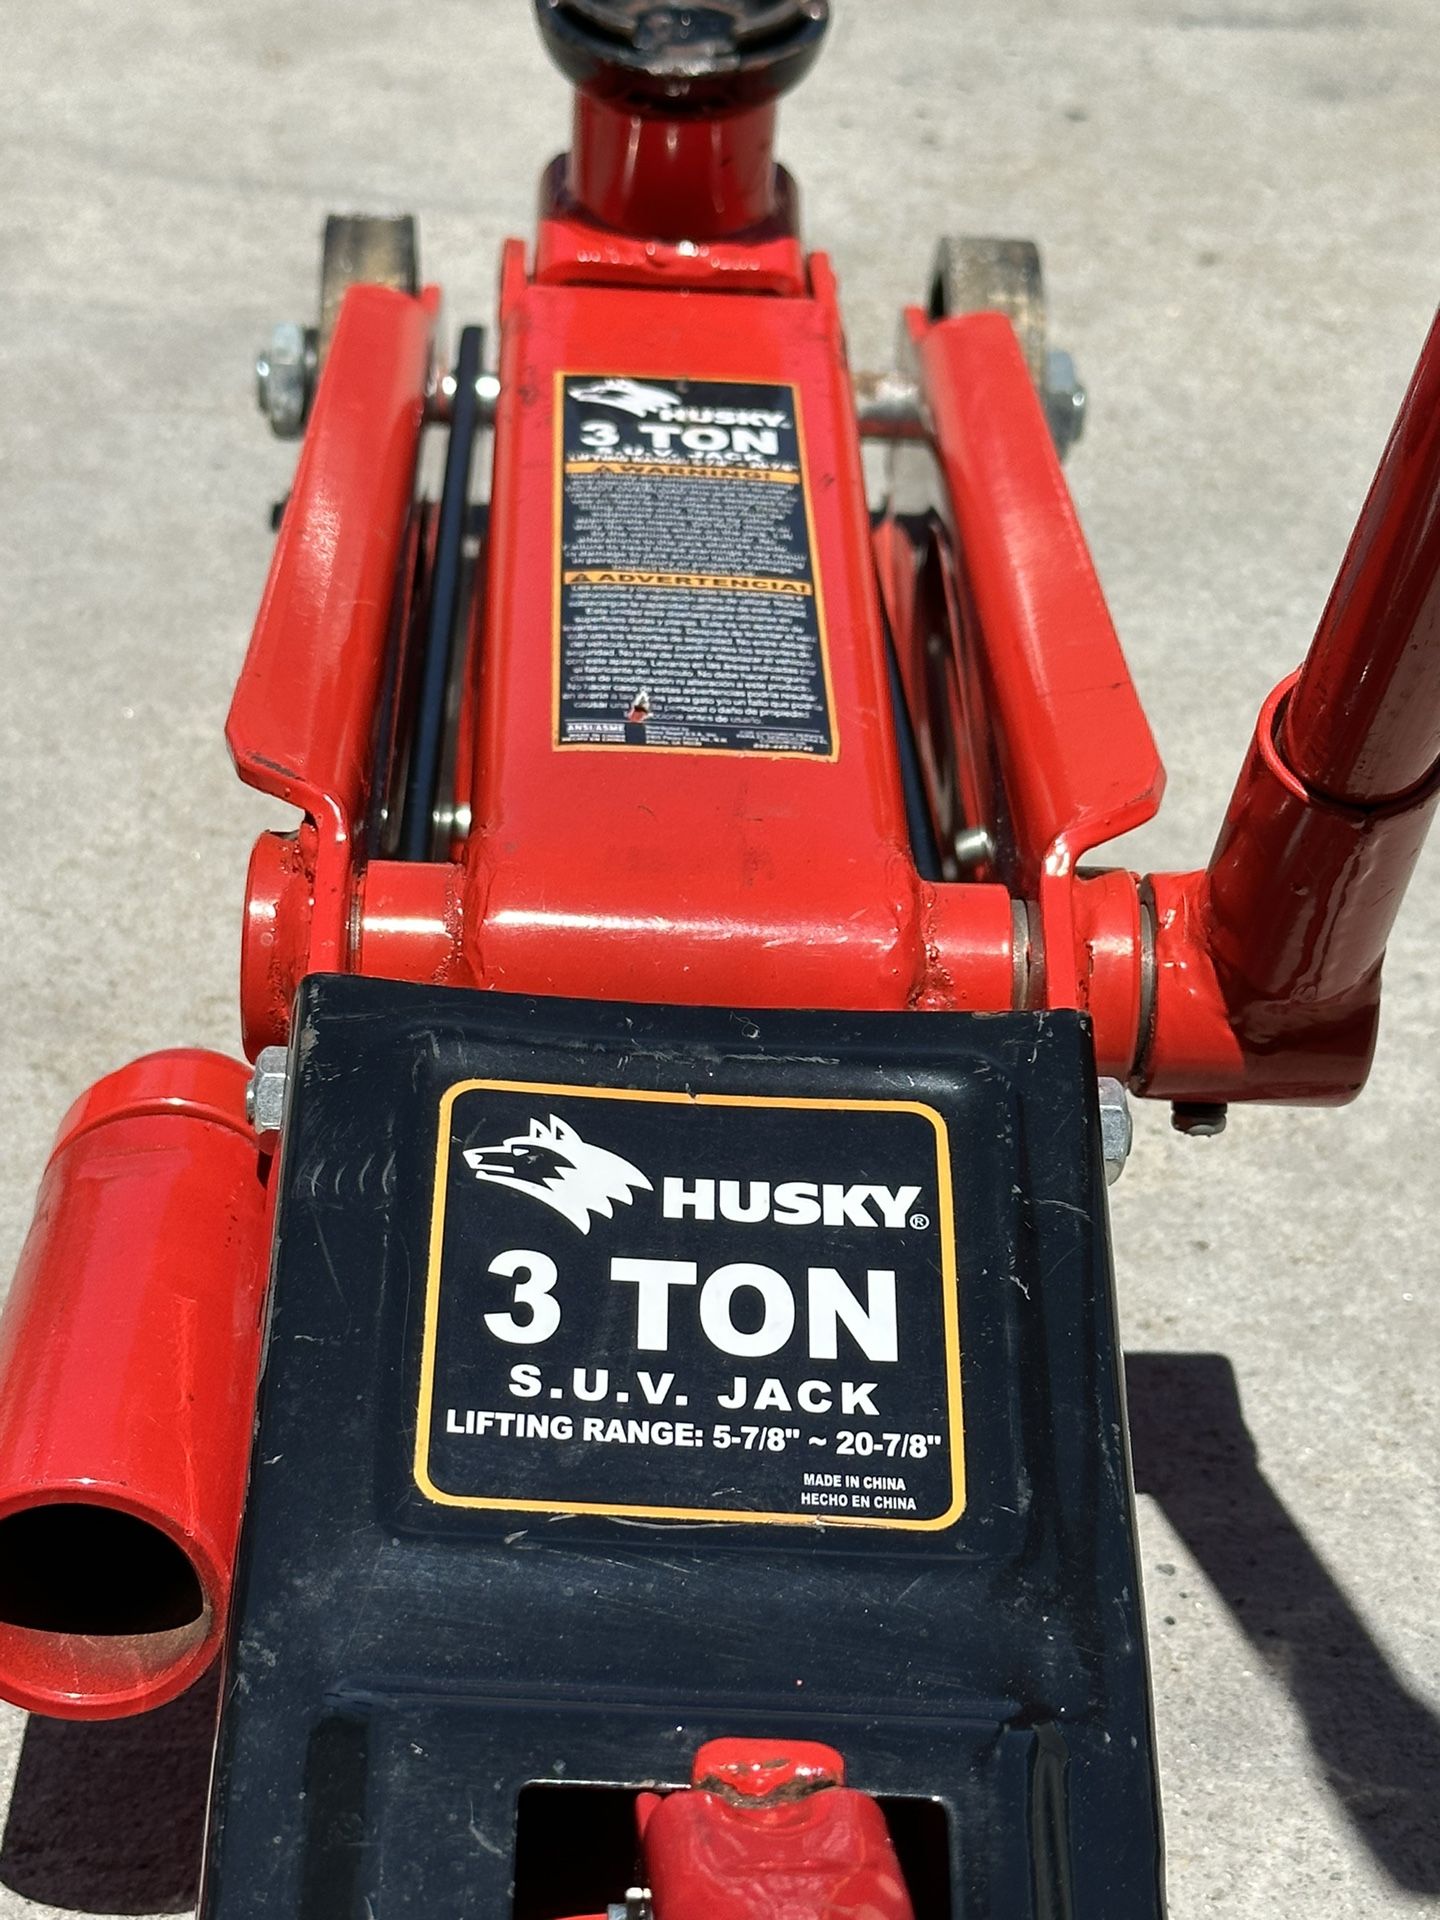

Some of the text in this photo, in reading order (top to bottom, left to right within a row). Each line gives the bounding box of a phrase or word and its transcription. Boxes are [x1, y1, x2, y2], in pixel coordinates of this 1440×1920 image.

[580, 419, 779, 455] 3 TON
[620, 465, 771, 479] WARNING!
[598, 574, 806, 593] ADVERTENCIA!
[585, 657, 607, 665] este
[650, 660, 690, 668] Levante
[584, 665, 633, 674] fabricante
[634, 667, 650, 675] del
[714, 671, 740, 679] debe
[653, 686, 681, 694] estas
[745, 681, 766, 689] este
[667, 696, 691, 704] para
[692, 697, 715, 706] gato
[484, 1250, 898, 1362] 3 TON
[509, 1364, 879, 1415] S.U.V. JACK
[447, 1409, 573, 1440] LIFTING
[583, 1418, 703, 1447] RANGE:
[713, 1425, 800, 1451] 5-7/8"
[836, 1431, 941, 1458] 20-7/8"
[804, 1473, 906, 1490] MADE IN CHINA
[801, 1493, 916, 1513] HECHO EN CHINA
